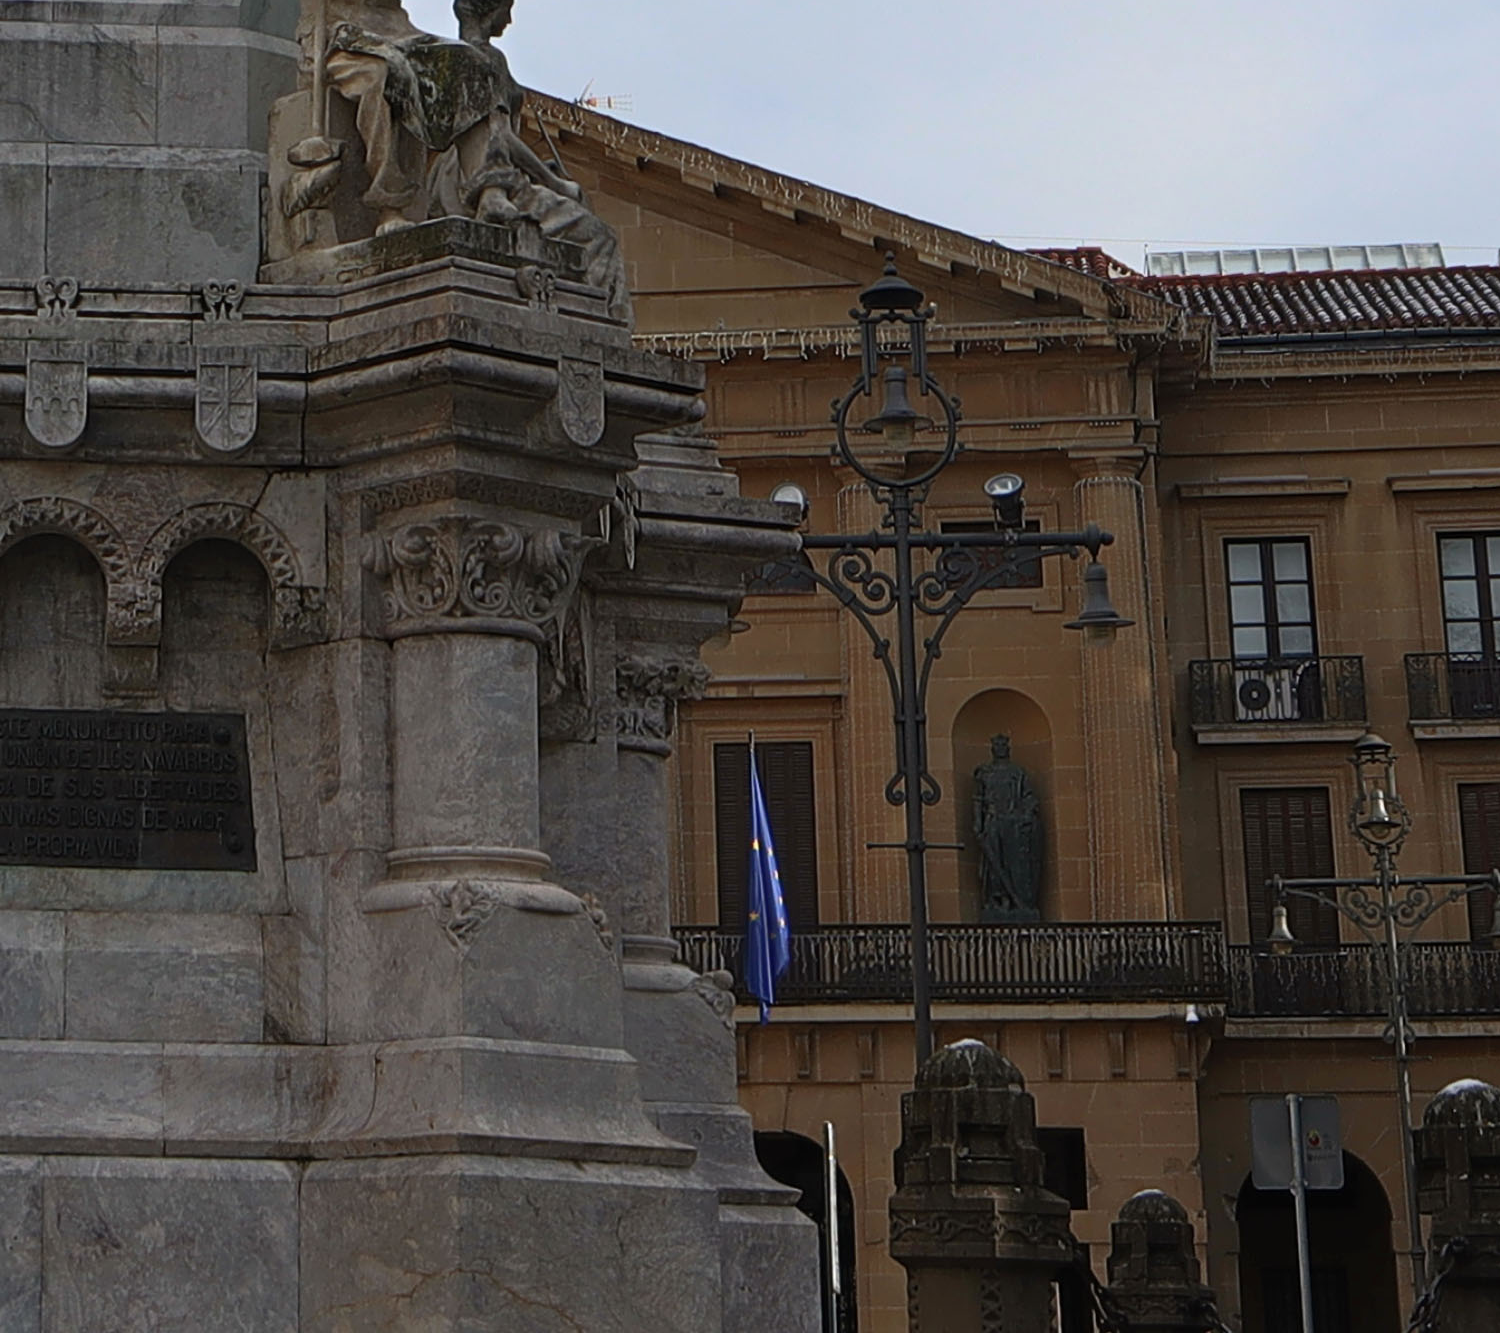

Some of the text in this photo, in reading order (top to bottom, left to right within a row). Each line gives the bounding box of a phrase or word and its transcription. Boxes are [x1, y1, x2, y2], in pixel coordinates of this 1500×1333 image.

[161, 721, 212, 744] PARA
[65, 746, 94, 770] DE
[97, 746, 135, 771] LOS
[140, 749, 239, 773] NAVARROS
[26, 775, 54, 798] DE
[64, 777, 105, 799] SUS
[66, 806, 136, 829] DIGNAS
[141, 806, 169, 830] DE
[174, 809, 228, 832] AMOR
[24, 836, 90, 859] PROPIA
[95, 837, 140, 862] VIDA
